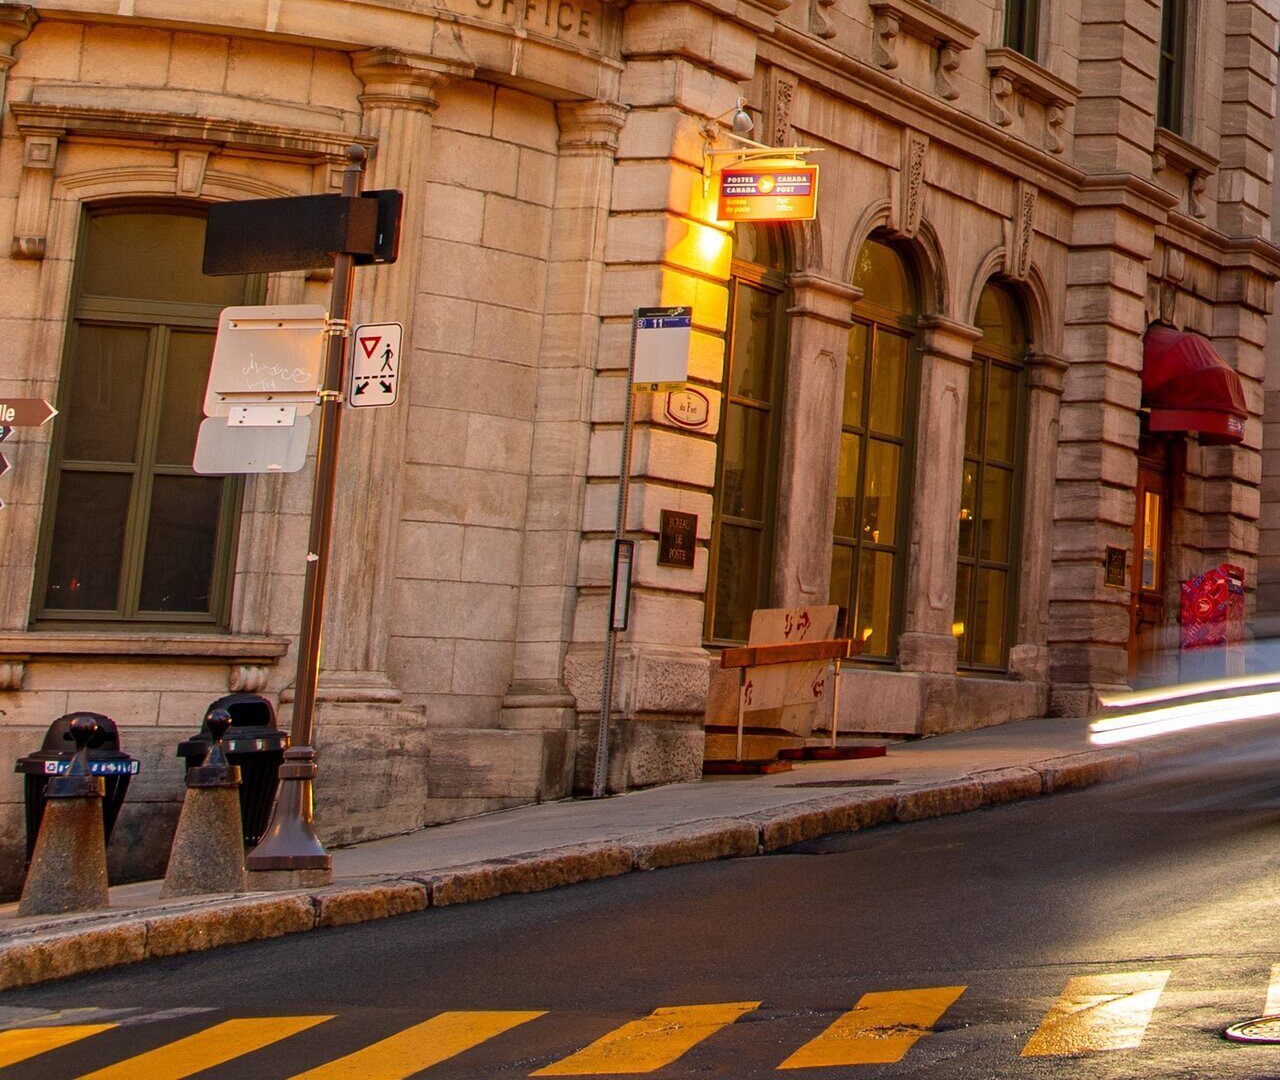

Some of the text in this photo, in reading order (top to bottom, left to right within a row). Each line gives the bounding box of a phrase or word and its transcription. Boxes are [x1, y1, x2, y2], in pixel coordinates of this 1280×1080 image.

[727, 175, 807, 184] POSTES CANADA
[726, 185, 795, 194] CANADA POST
[652, 319, 663, 328] 11
